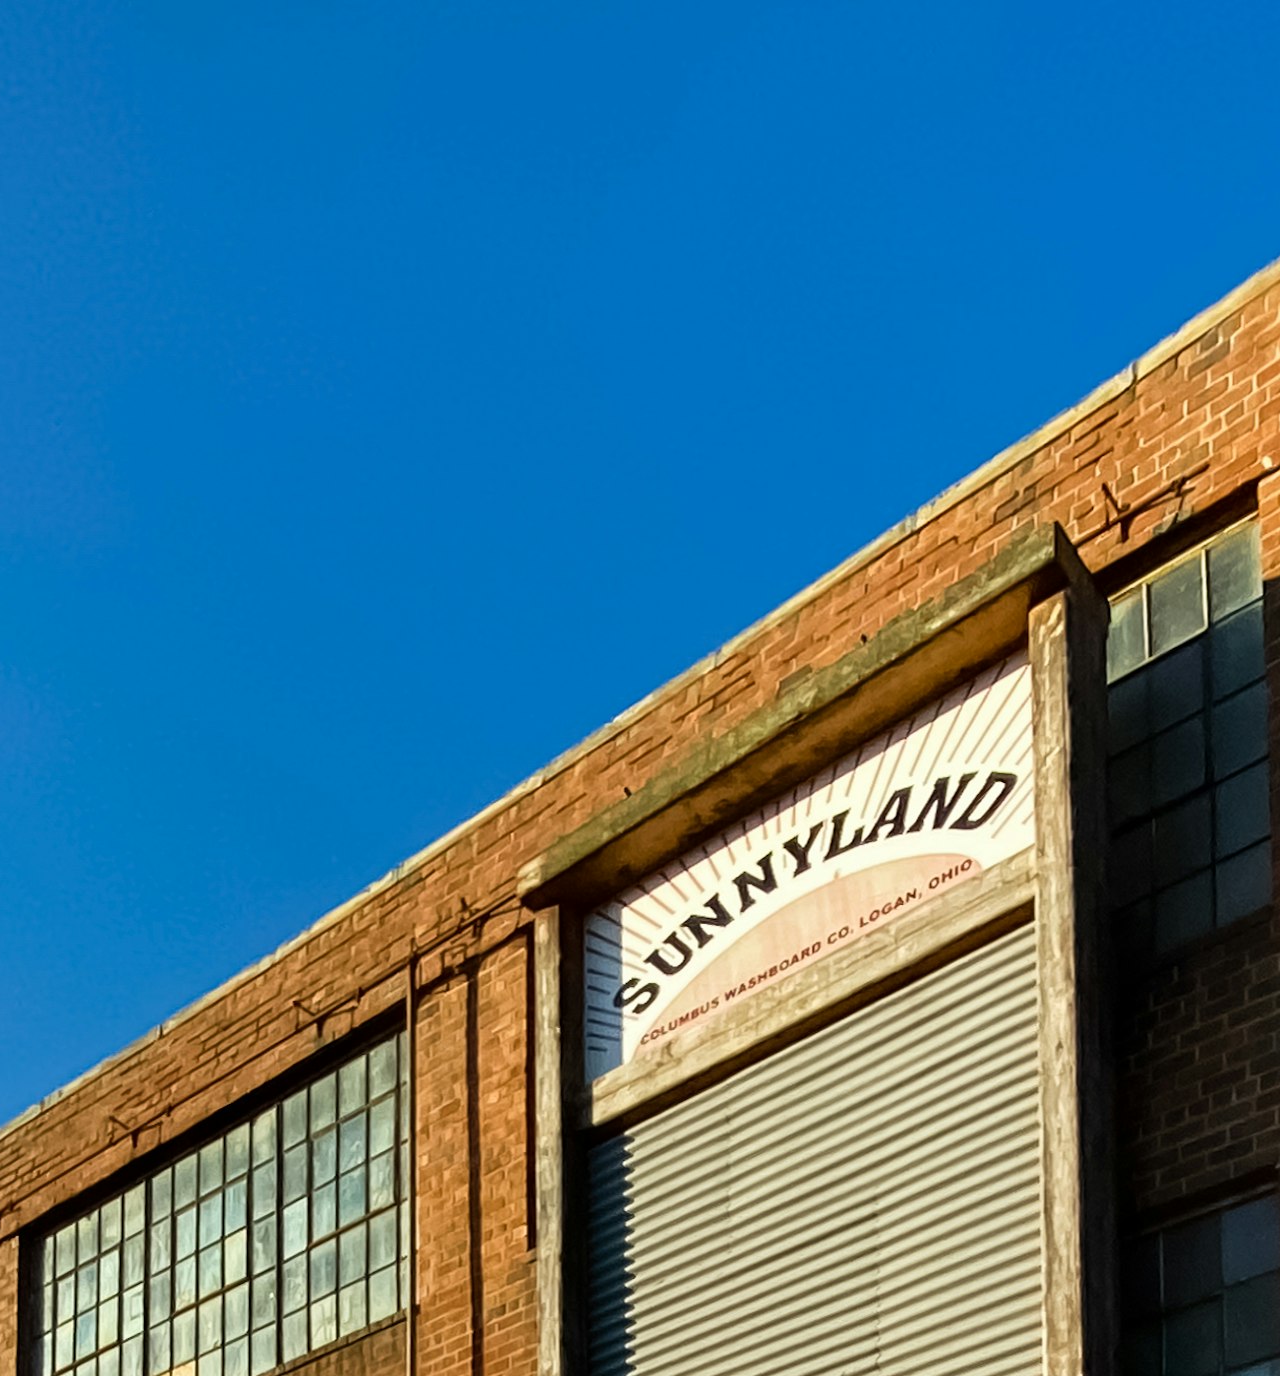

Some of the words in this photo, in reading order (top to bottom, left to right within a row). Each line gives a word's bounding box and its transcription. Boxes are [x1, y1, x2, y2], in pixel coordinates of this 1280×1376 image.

[613, 771, 1018, 1015] SUNNYLAND
[640, 996, 720, 1046] COLUMBUS
[724, 940, 822, 1002] WASHBOARD
[859, 888, 922, 929] LOGAN,
[928, 858, 973, 890] OHIO
